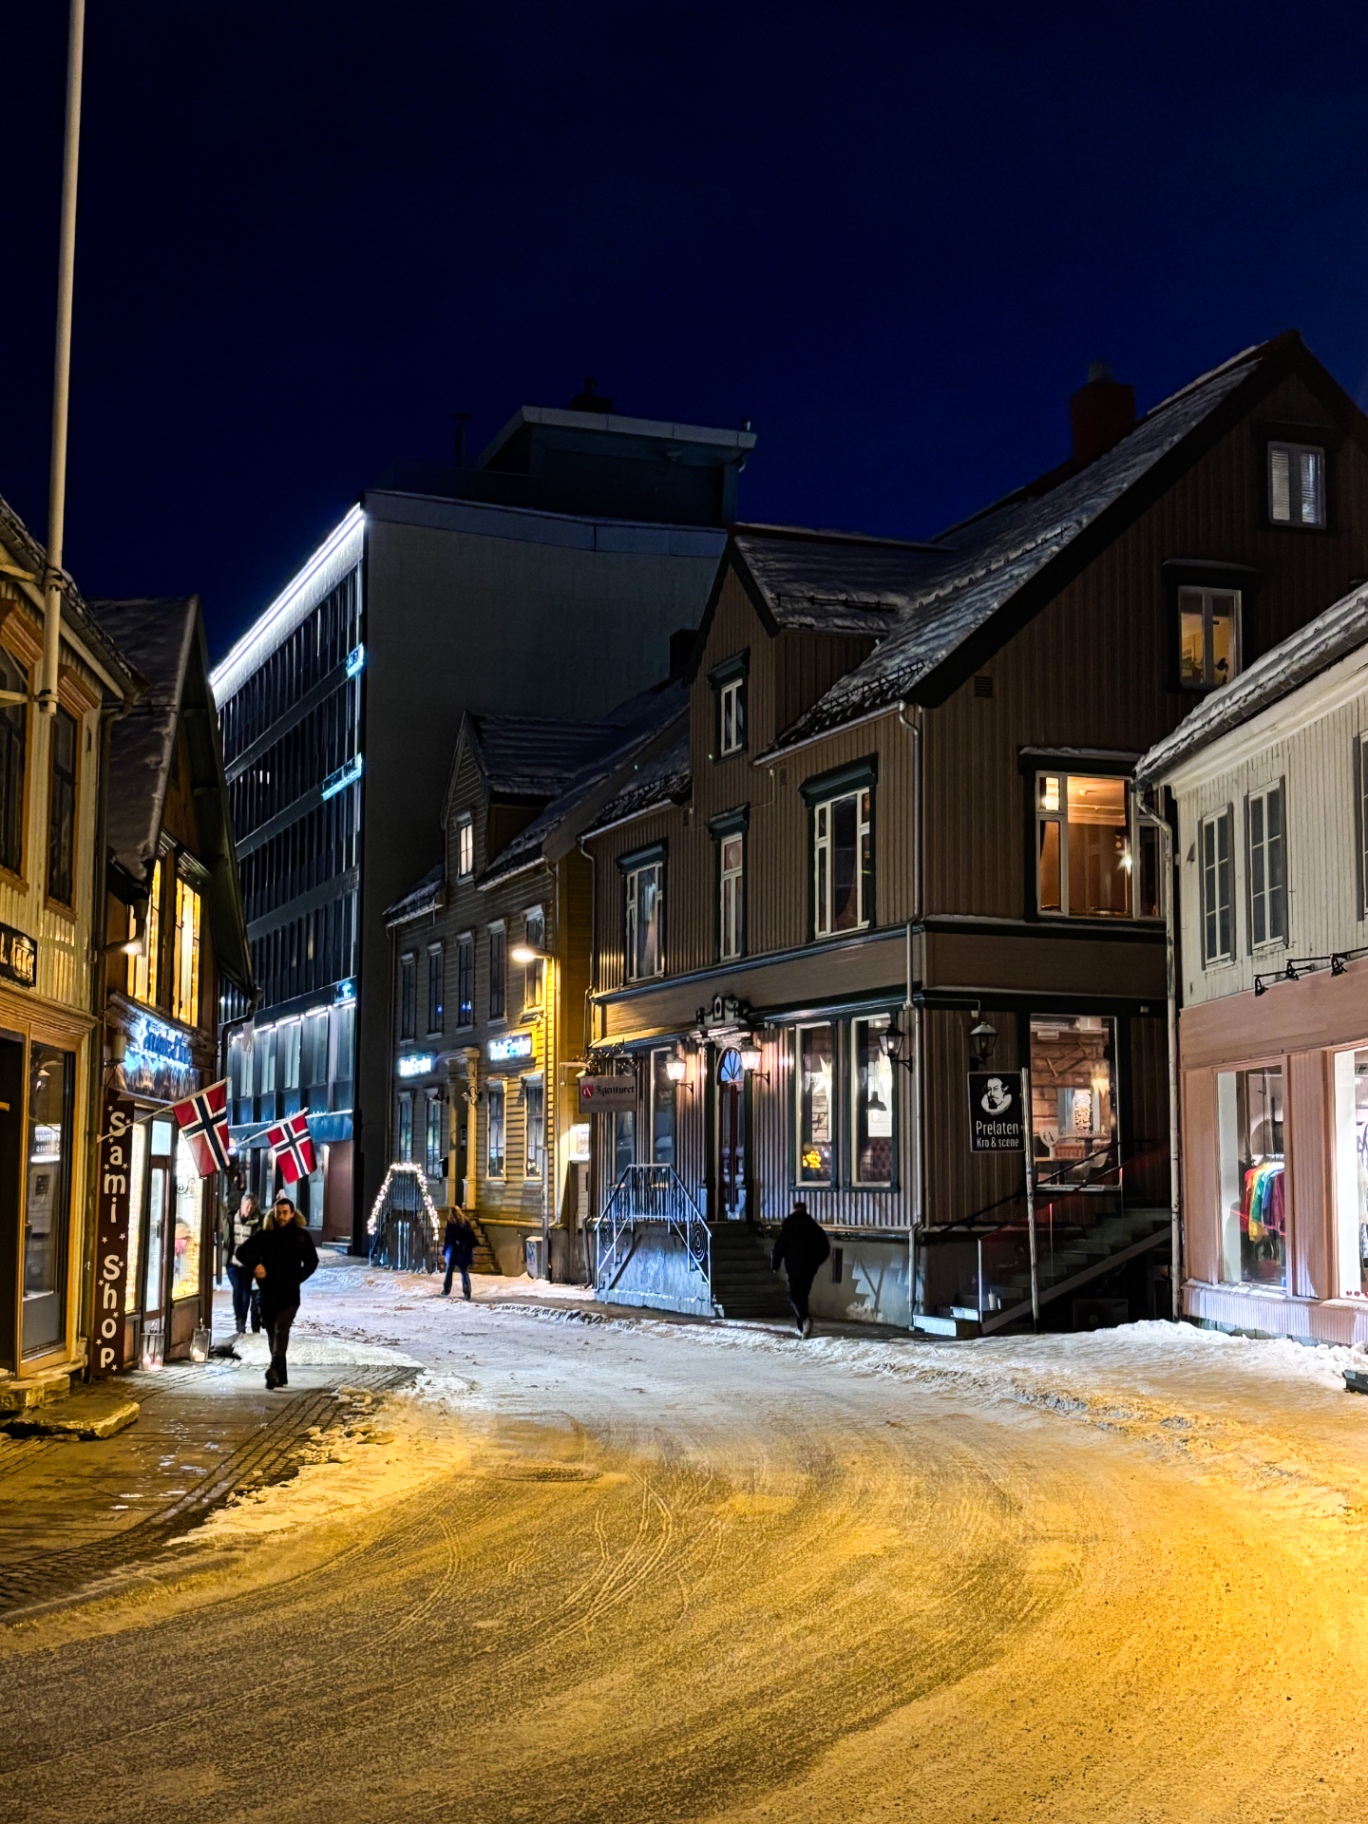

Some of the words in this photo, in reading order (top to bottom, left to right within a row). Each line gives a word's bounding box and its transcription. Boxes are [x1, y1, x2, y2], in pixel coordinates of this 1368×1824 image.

[975, 1120, 1020, 1136] Prelaten
[976, 1137, 990, 1148] Kro
[990, 1136, 997, 1148] &
[998, 1138, 1020, 1148] scene
[103, 1111, 126, 1224] Sami
[100, 1254, 121, 1369] Shop
